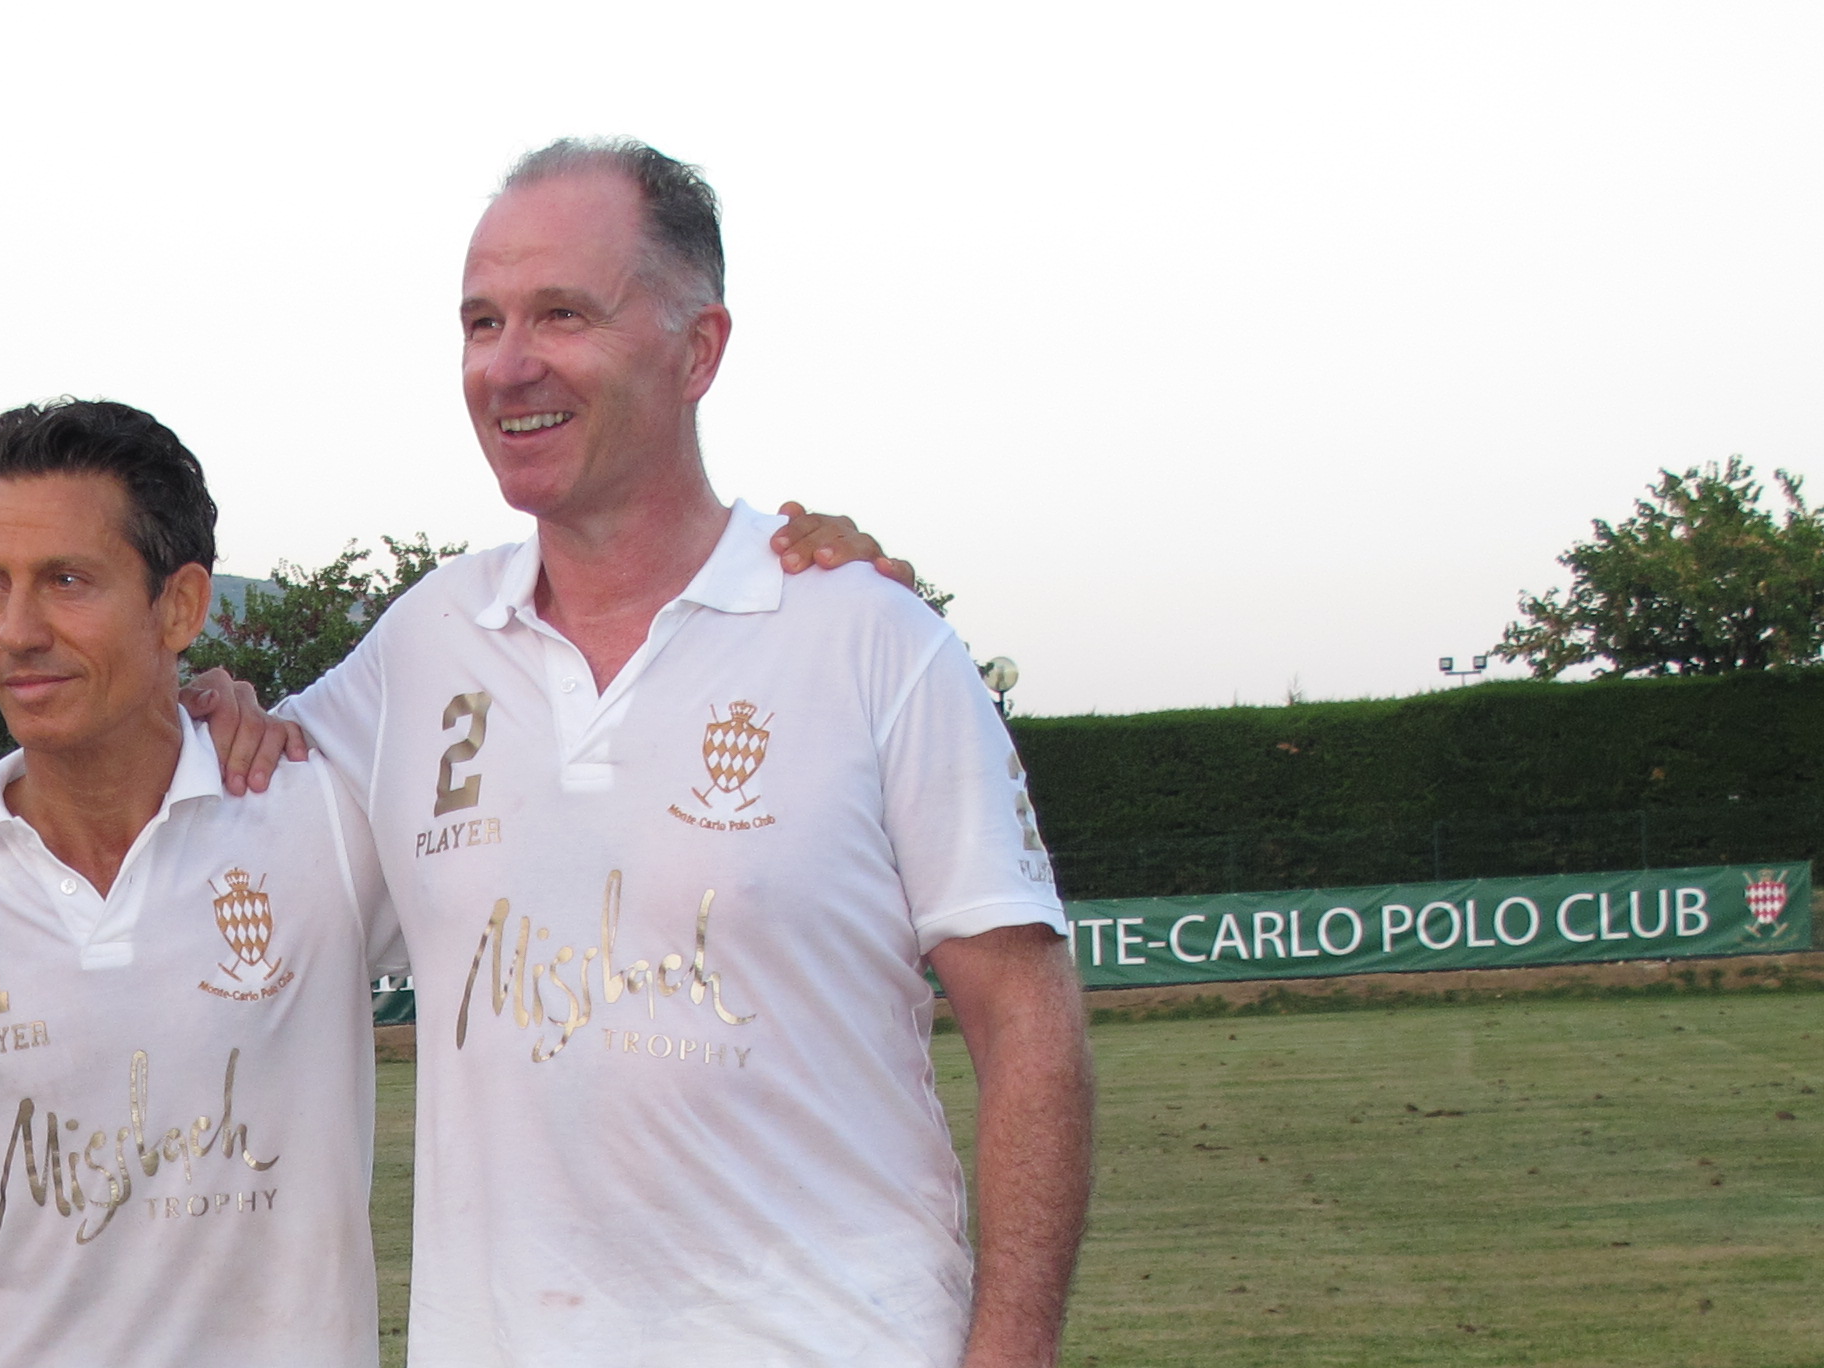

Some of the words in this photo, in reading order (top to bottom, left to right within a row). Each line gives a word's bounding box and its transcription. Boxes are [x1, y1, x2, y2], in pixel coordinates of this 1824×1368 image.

[434, 690, 493, 818] 2
[415, 817, 502, 859] PLAYER
[1068, 907, 1363, 966] TE-CARLO
[1382, 896, 1540, 953] POLO
[1557, 887, 1710, 943] CLUB
[602, 1028, 752, 1069] TROPHY
[143, 1187, 278, 1220] TROPHY
